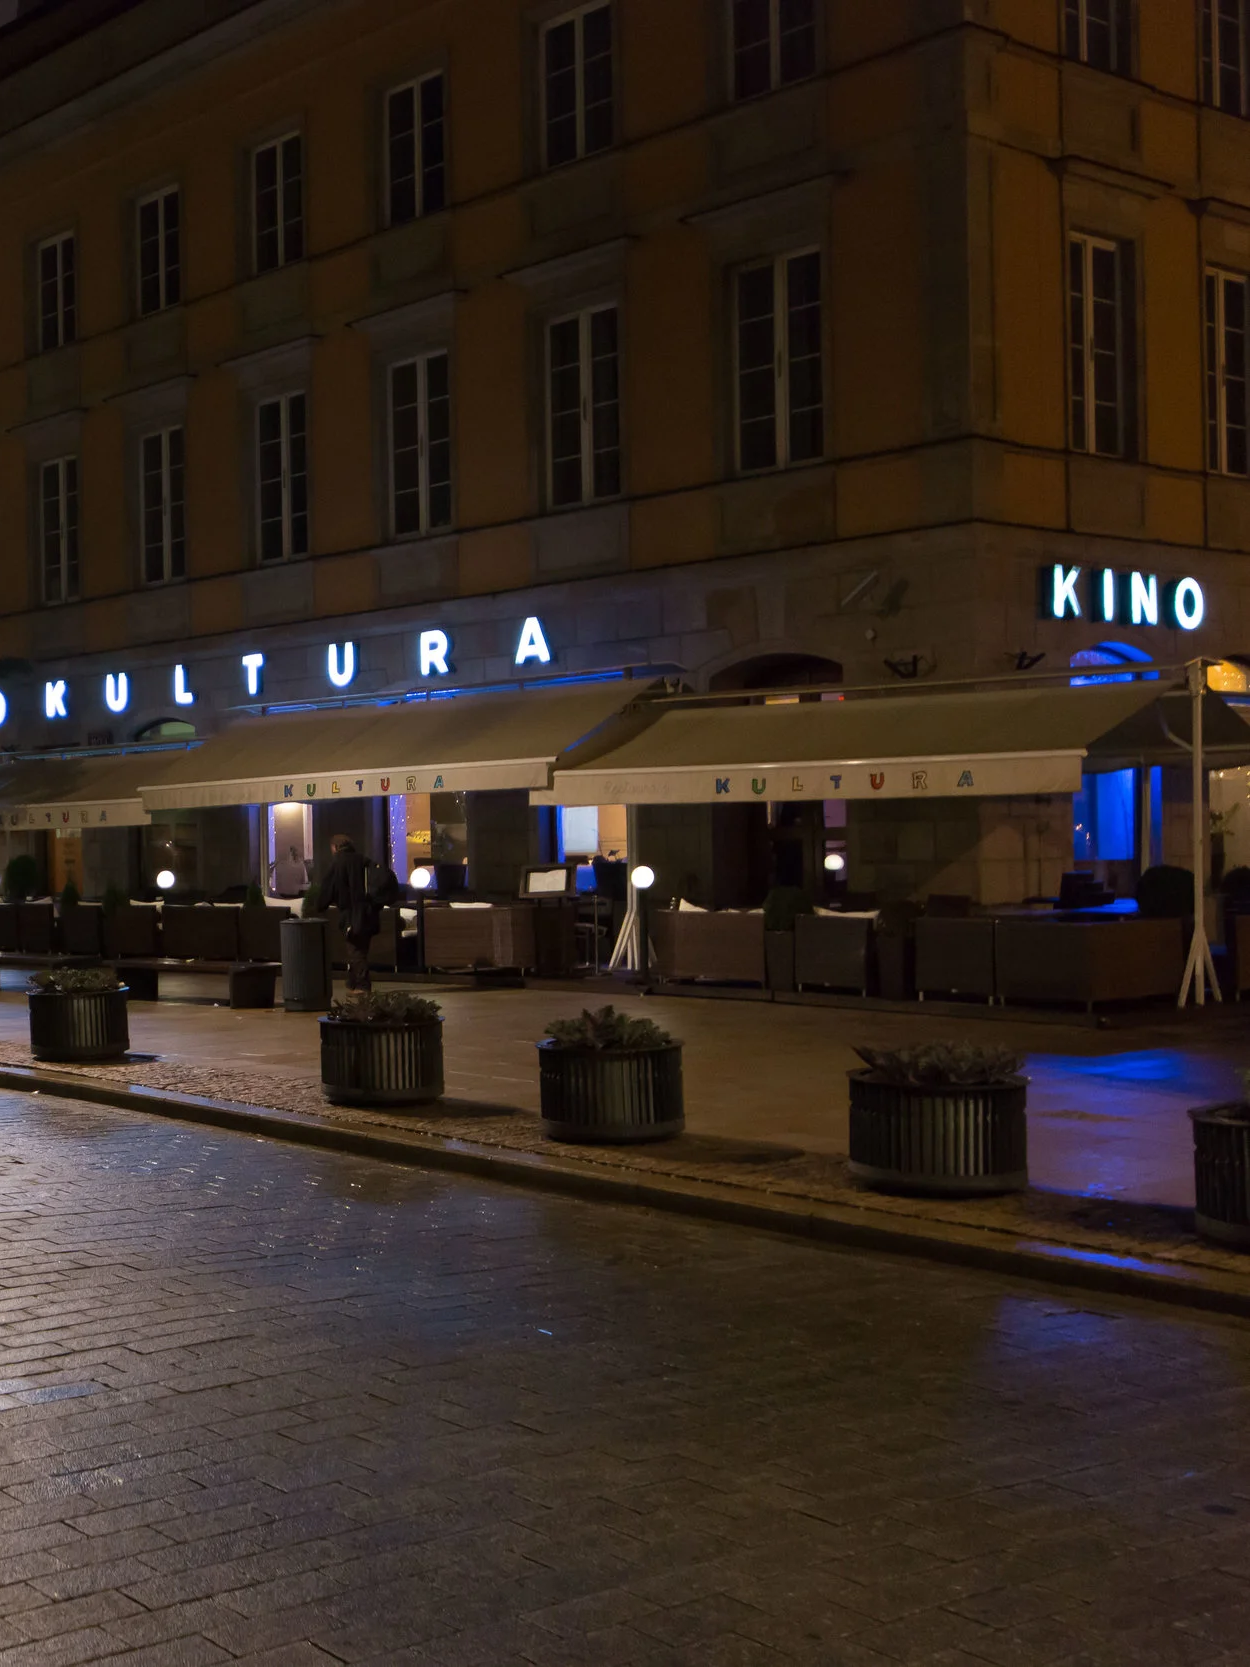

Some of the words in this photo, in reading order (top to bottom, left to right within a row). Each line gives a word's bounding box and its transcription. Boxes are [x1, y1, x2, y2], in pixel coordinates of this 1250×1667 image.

[1052, 563, 1204, 630] KINO
[44, 616, 551, 718] KULTURA
[284, 775, 444, 797] KULTURA
[715, 770, 974, 795] KULTURA
